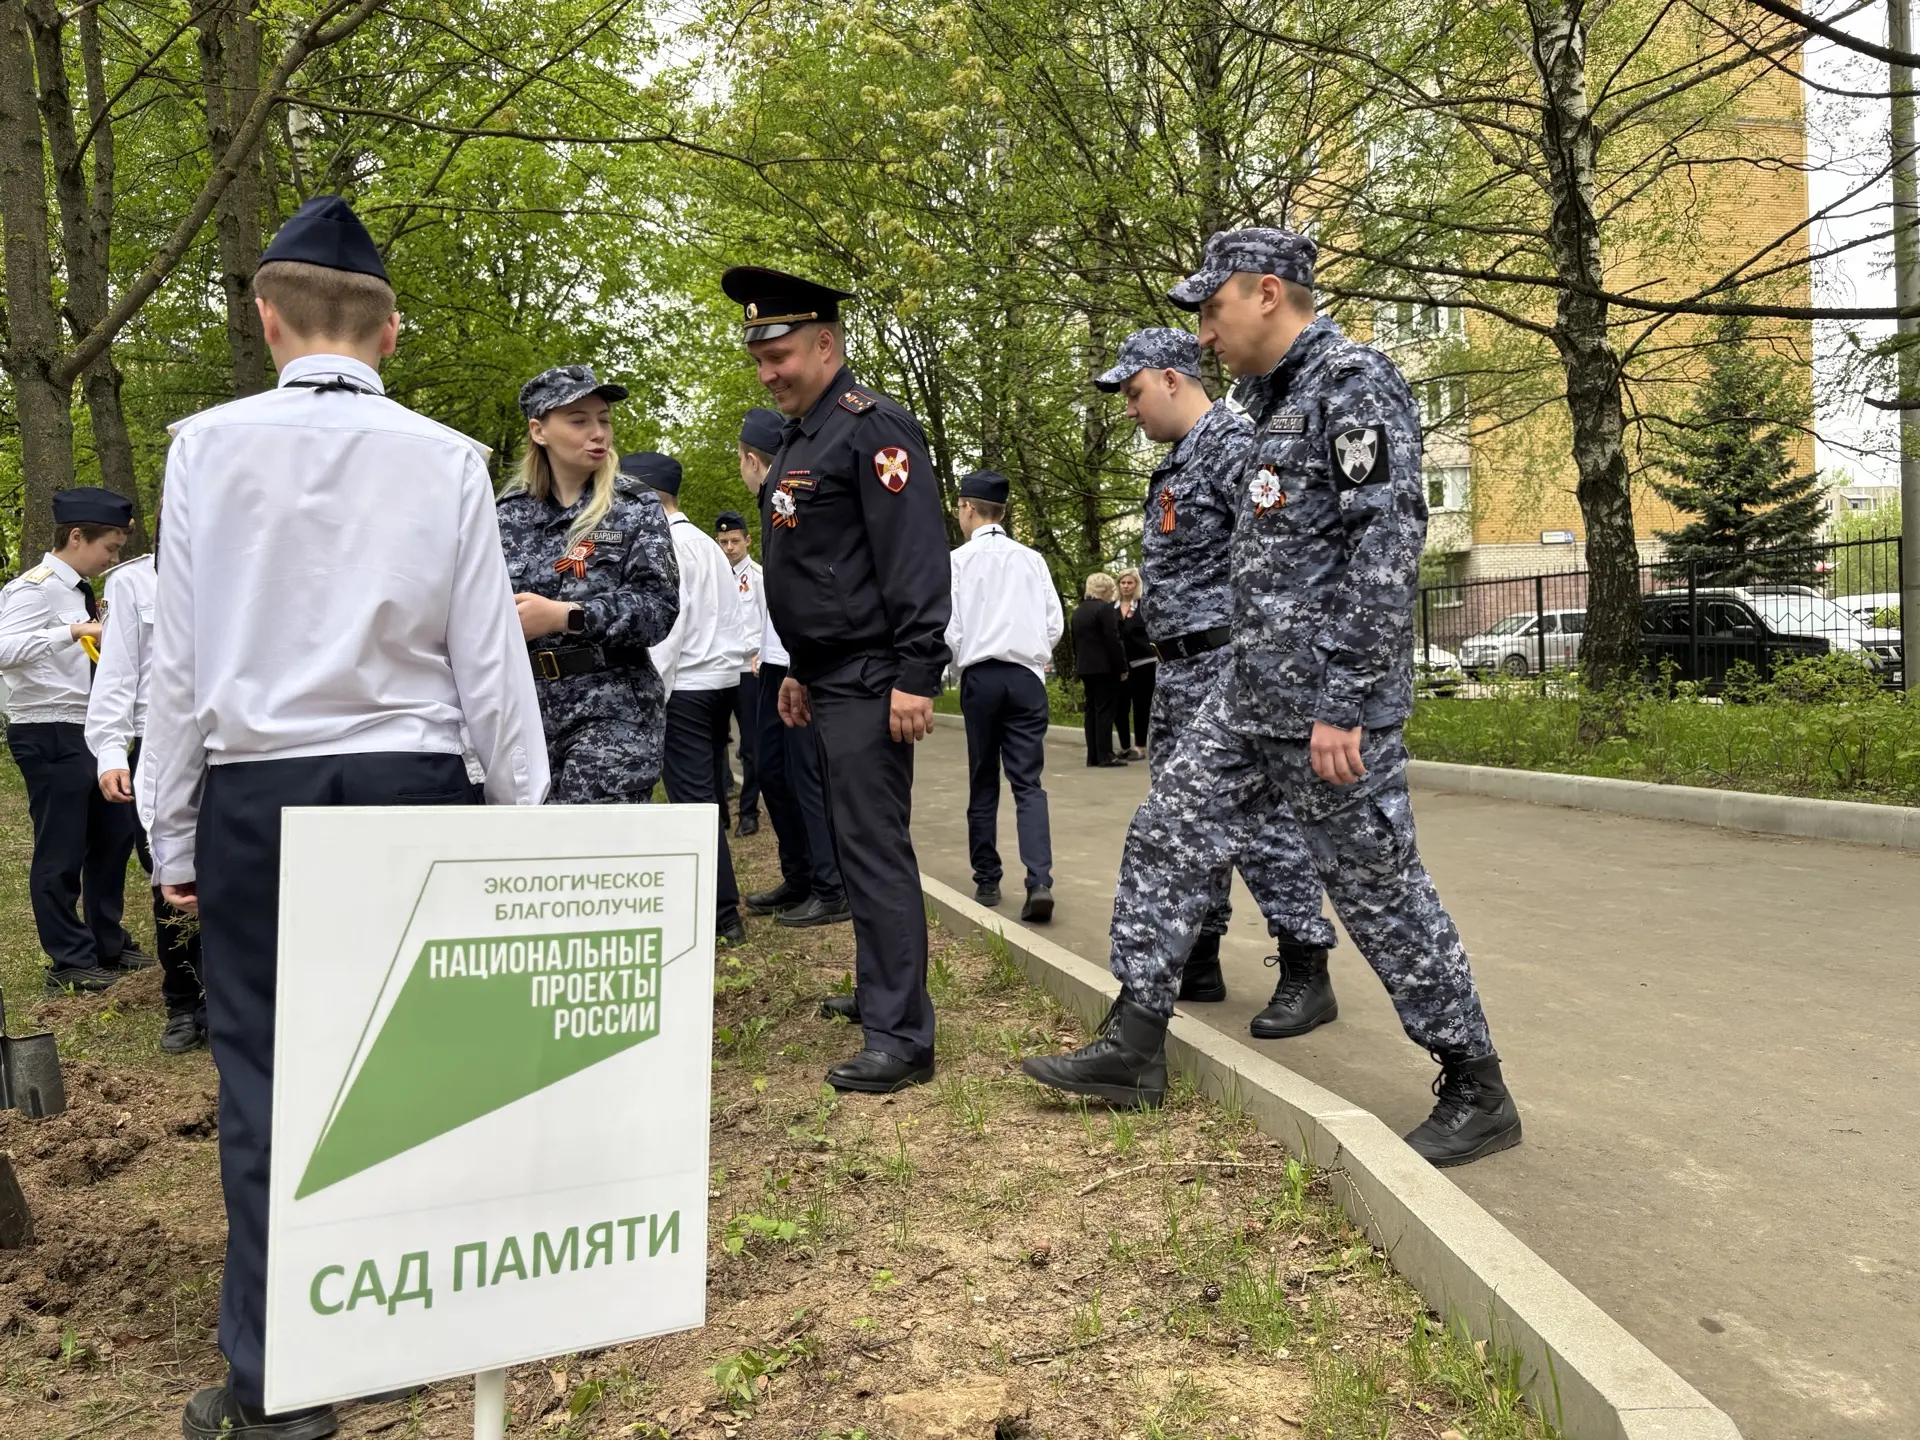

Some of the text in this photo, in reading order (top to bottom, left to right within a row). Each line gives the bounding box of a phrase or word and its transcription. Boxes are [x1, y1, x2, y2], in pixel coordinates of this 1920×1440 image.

[484, 871, 665, 894] ЭКОЛОГИЧЕСКОЕ
[495, 897, 664, 921] БЛАГОПОЛУЧИЕ
[429, 933, 658, 979] НАЦИОНАЛЬНЫЕ
[531, 967, 656, 1007] ПРОЕКТЫ
[554, 1001, 656, 1040] РОССИИ
[309, 1210, 680, 1316] САД ПАМЯТИ
